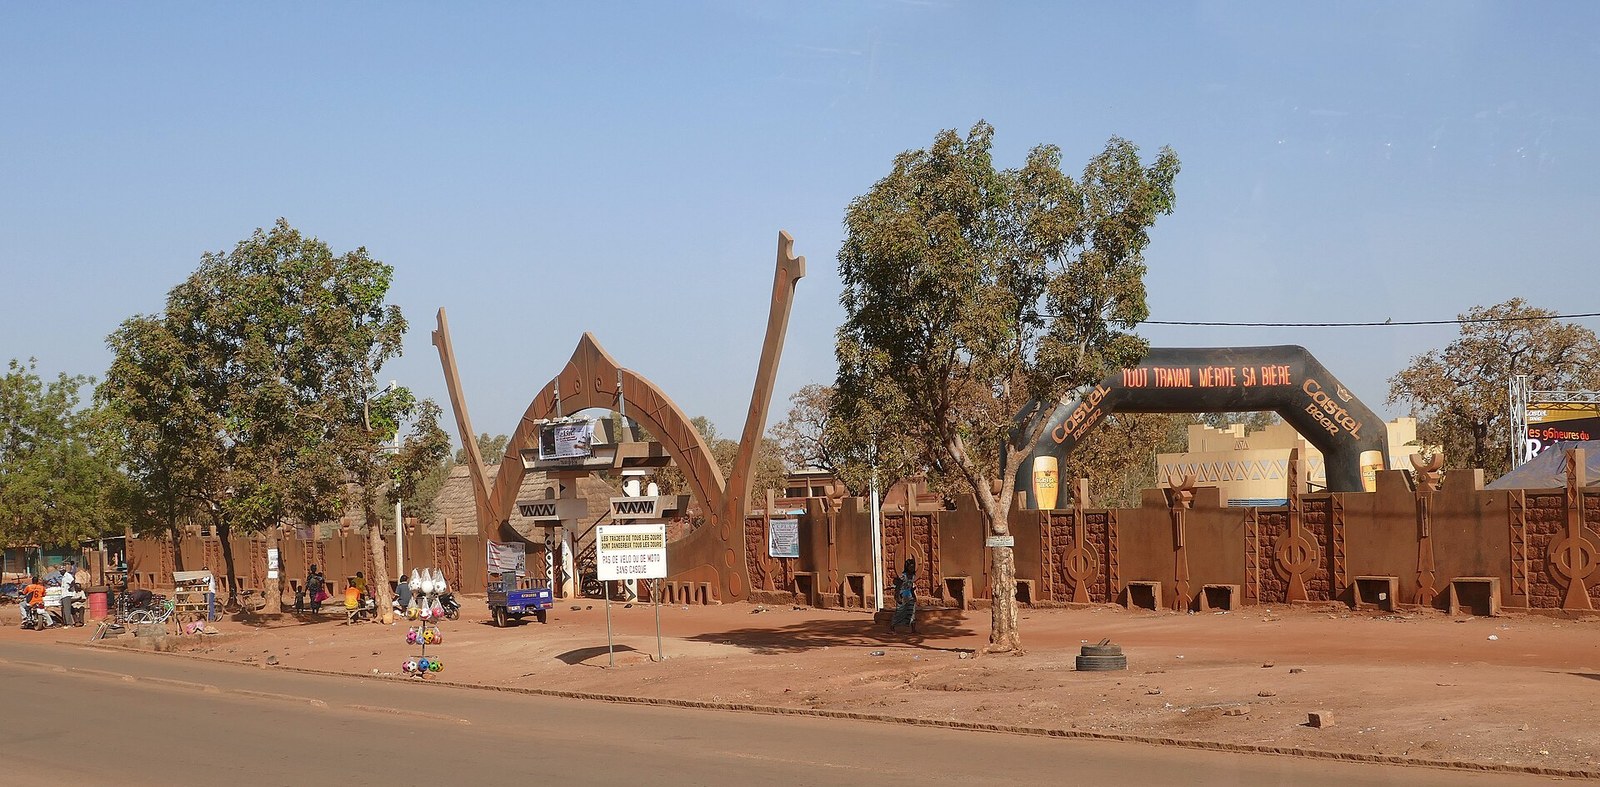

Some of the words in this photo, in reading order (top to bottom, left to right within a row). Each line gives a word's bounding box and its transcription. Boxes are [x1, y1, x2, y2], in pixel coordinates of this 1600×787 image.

[1121, 367, 1148, 388] TOUT
[1153, 367, 1193, 388] TRAVAIL
[1198, 365, 1237, 388] MÉRITE
[1242, 366, 1257, 387] SA
[1261, 364, 1292, 386] BIÈRE
[1528, 428, 1541, 438] es
[1580, 430, 1590, 440] du
[602, 555, 611, 564] PAS
[612, 555, 618, 564] DE
[619, 554, 631, 563] VELO
[632, 554, 639, 563] OU
[640, 554, 646, 563] DE
[647, 553, 660, 562] MOTO
[616, 565, 628, 574] SANS
[629, 565, 647, 574] CASQUE
